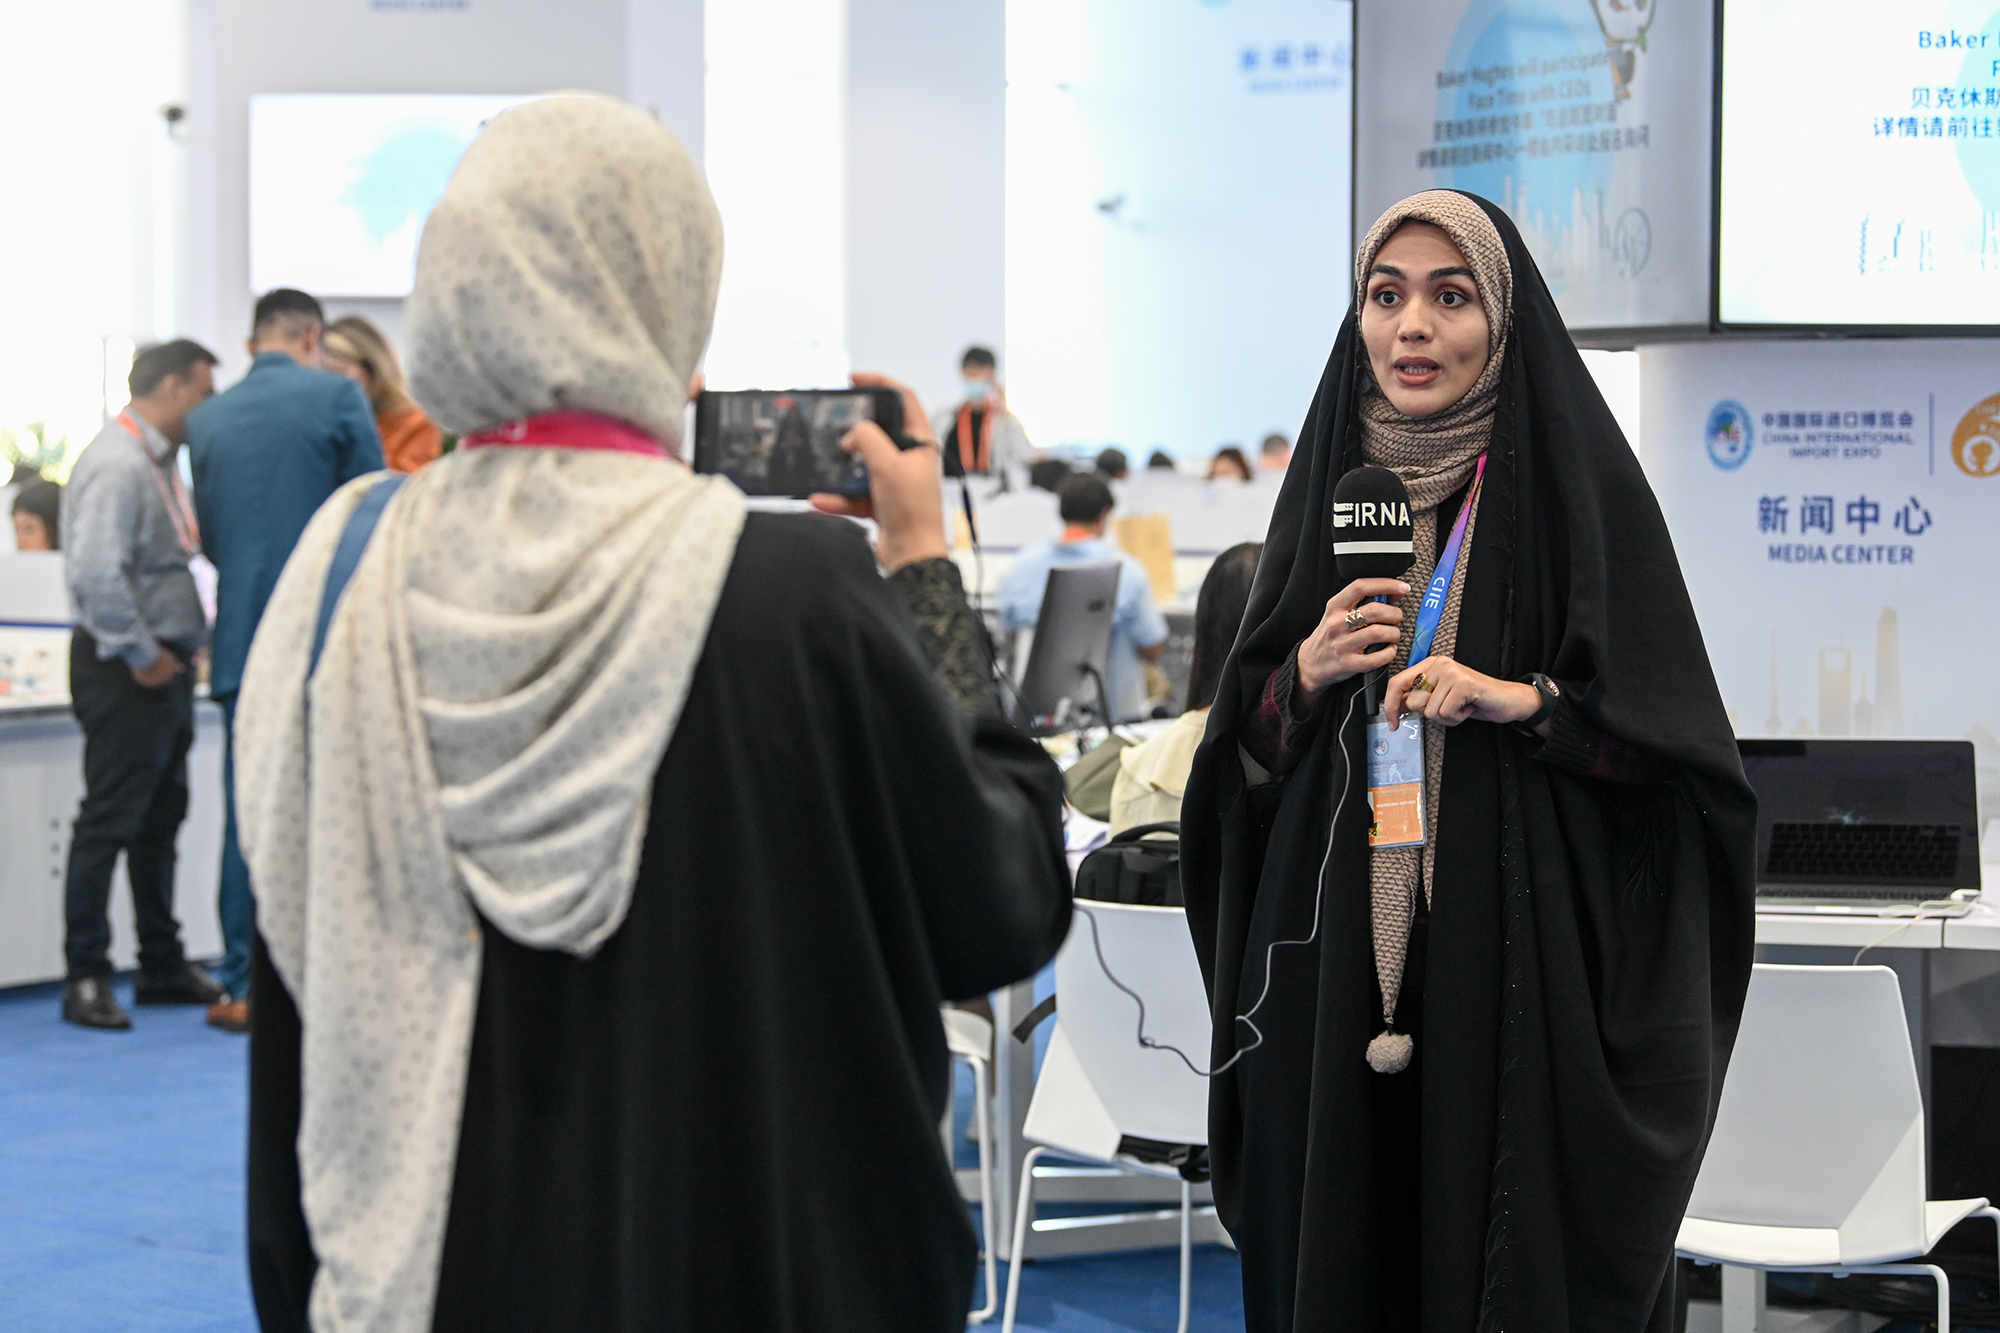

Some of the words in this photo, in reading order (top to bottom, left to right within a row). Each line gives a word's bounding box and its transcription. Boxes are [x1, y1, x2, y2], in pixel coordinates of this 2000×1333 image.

[1918, 29, 1989, 49] Baker
[1873, 116, 2000, 138] 详情请前往
[1761, 431, 1800, 446] CHINA
[1805, 431, 1915, 446] INTERNATIONAL
[1789, 446, 1839, 460] IMPORT
[1842, 446, 1882, 460] EXPO
[1354, 502, 1411, 527] IRNA
[1757, 494, 1933, 536] 新闻中心
[1767, 543, 1828, 563] MEDIA
[1831, 544, 1916, 565] CENTER
[1424, 576, 1446, 610] CIIE
